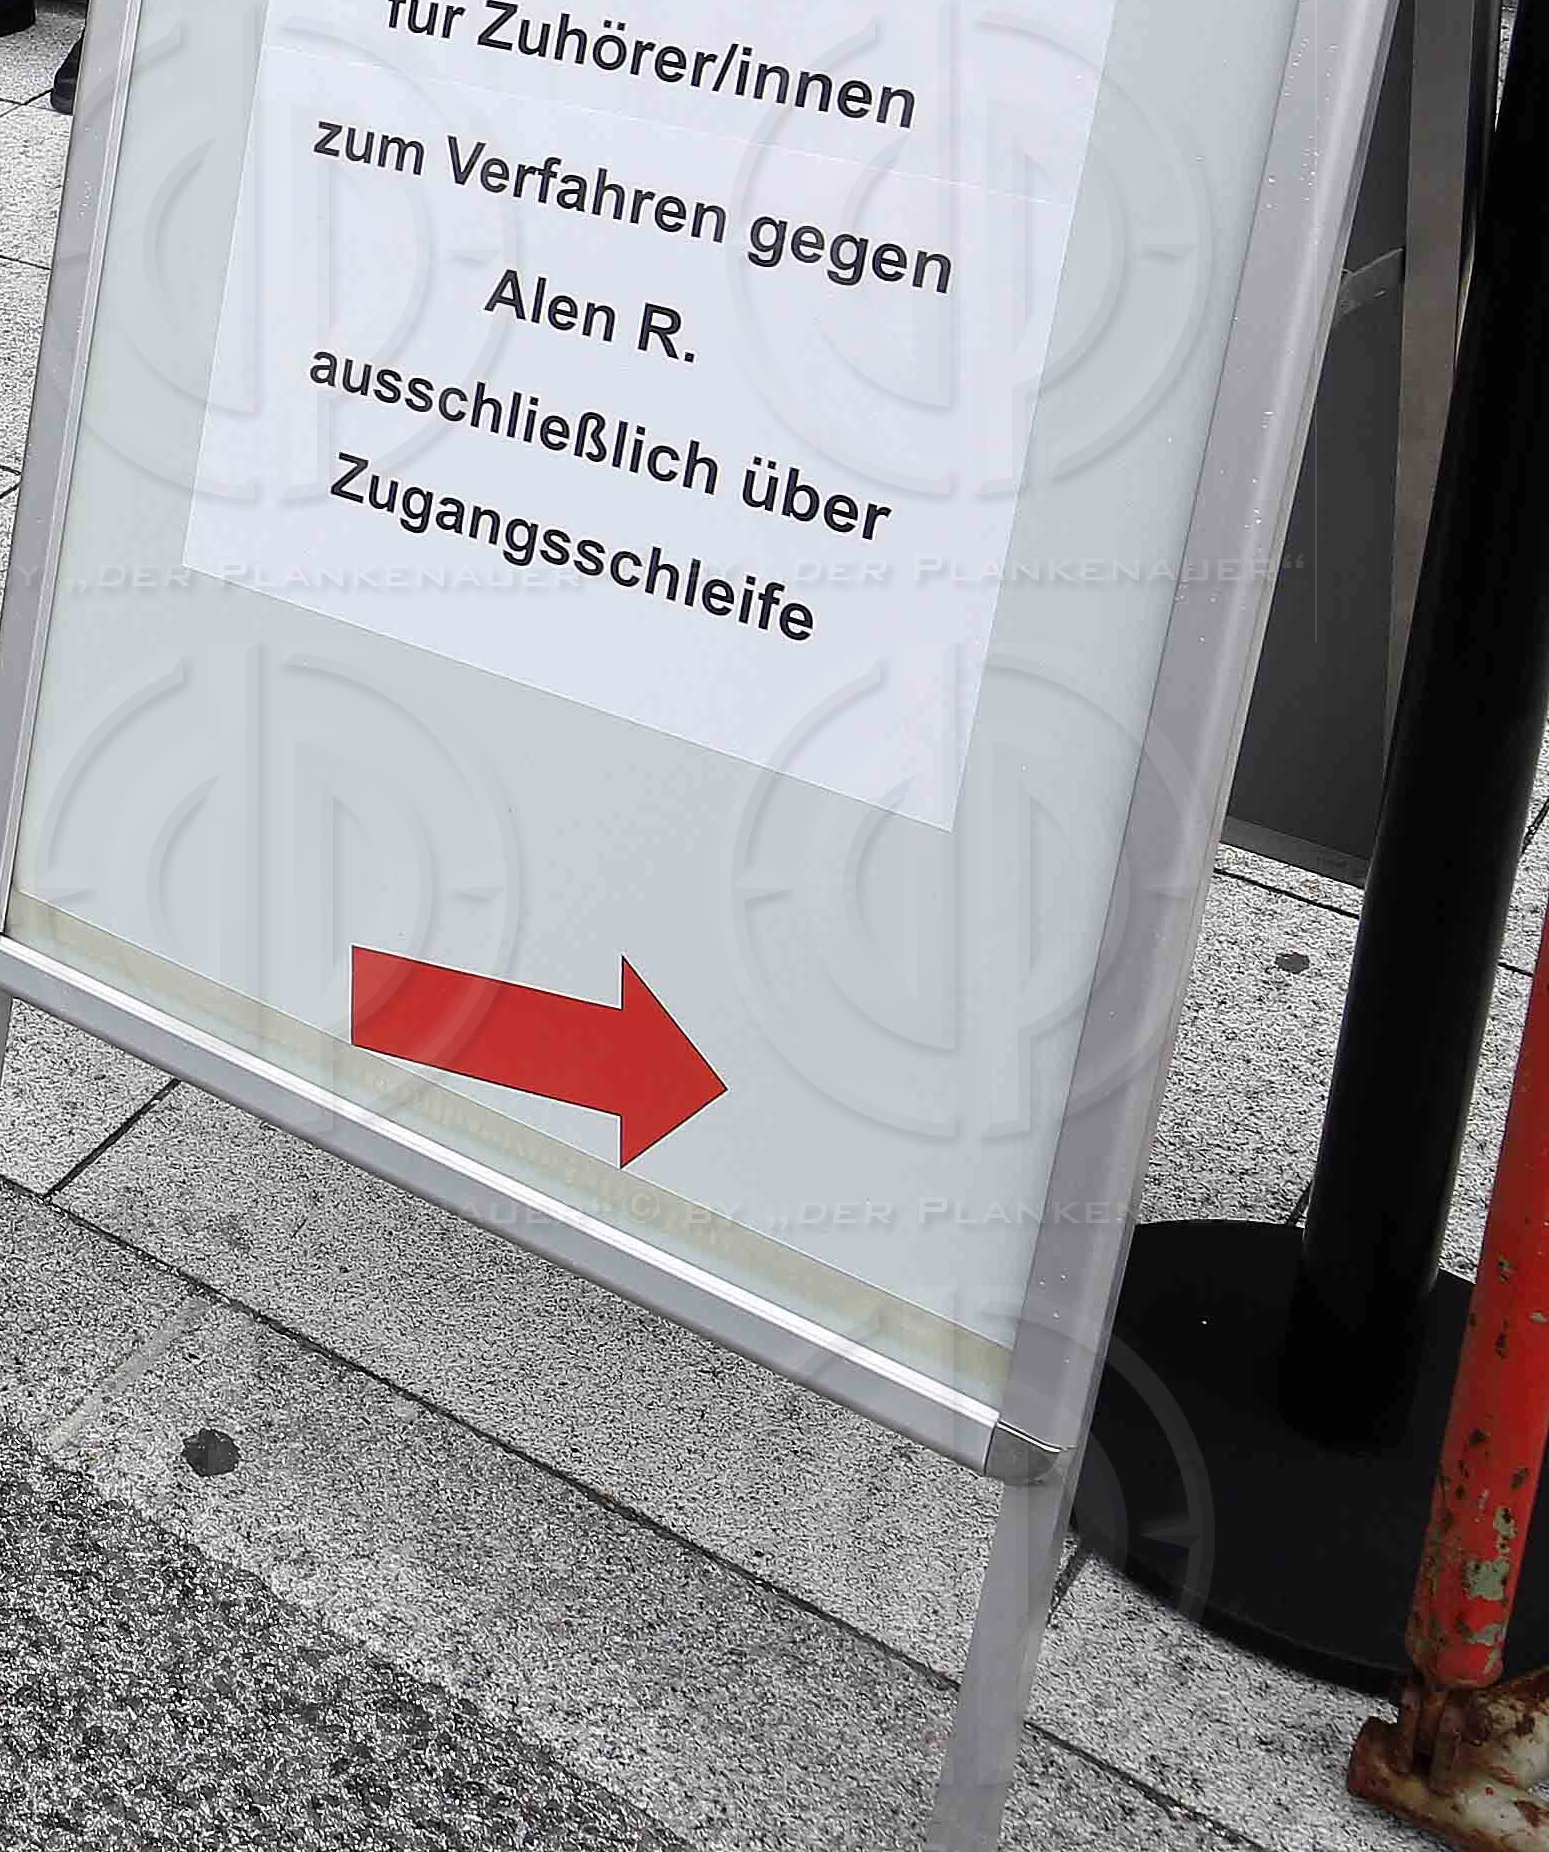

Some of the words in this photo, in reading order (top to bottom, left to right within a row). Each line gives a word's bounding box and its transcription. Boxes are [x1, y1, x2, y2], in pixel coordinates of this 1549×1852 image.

[477, 0, 916, 129] Zuhörer/innen
[313, 121, 425, 176] zum
[447, 135, 727, 244] Verfahren
[747, 216, 953, 294] gegen
[484, 269, 616, 342] Alen
[637, 302, 696, 364] R.
[309, 351, 719, 496] ausschließlich
[741, 456, 893, 541] über
[330, 451, 815, 641] Zugangsschleife
